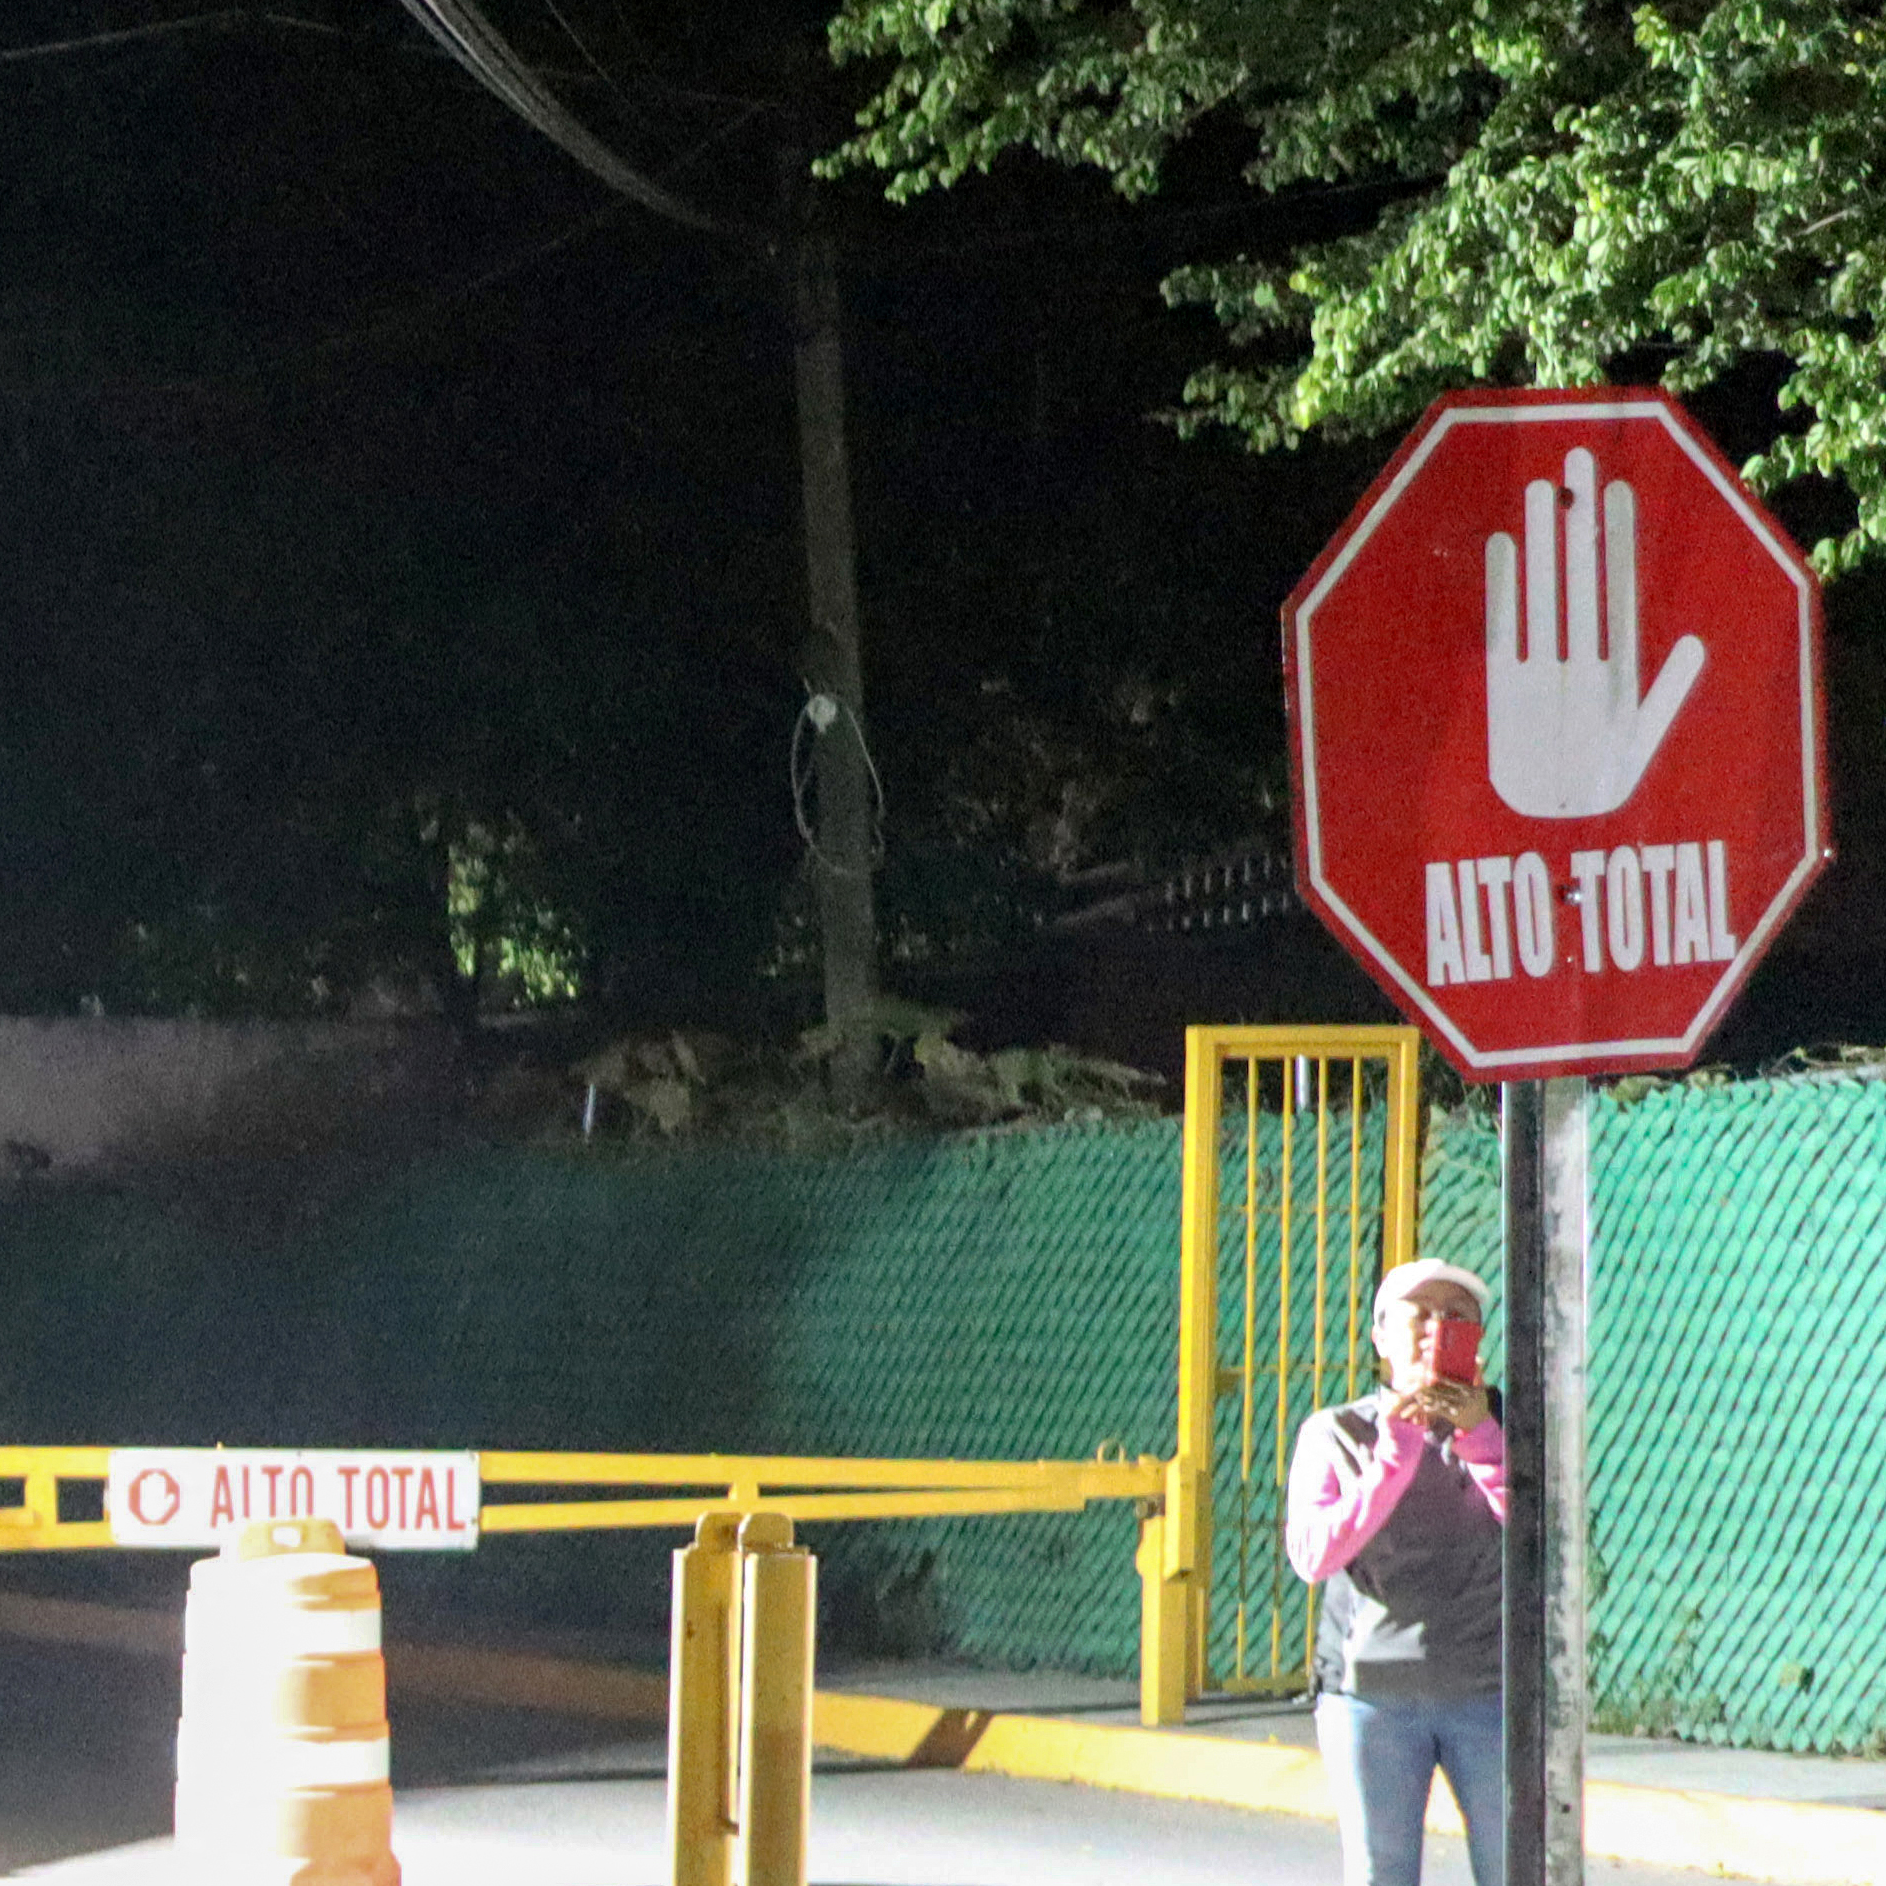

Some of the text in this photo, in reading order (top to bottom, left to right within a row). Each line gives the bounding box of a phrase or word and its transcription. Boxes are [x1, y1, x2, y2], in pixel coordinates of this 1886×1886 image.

[1425, 840, 1736, 986] ALTO TOTAL
[210, 1464, 466, 1530] ALTO TOTAL
